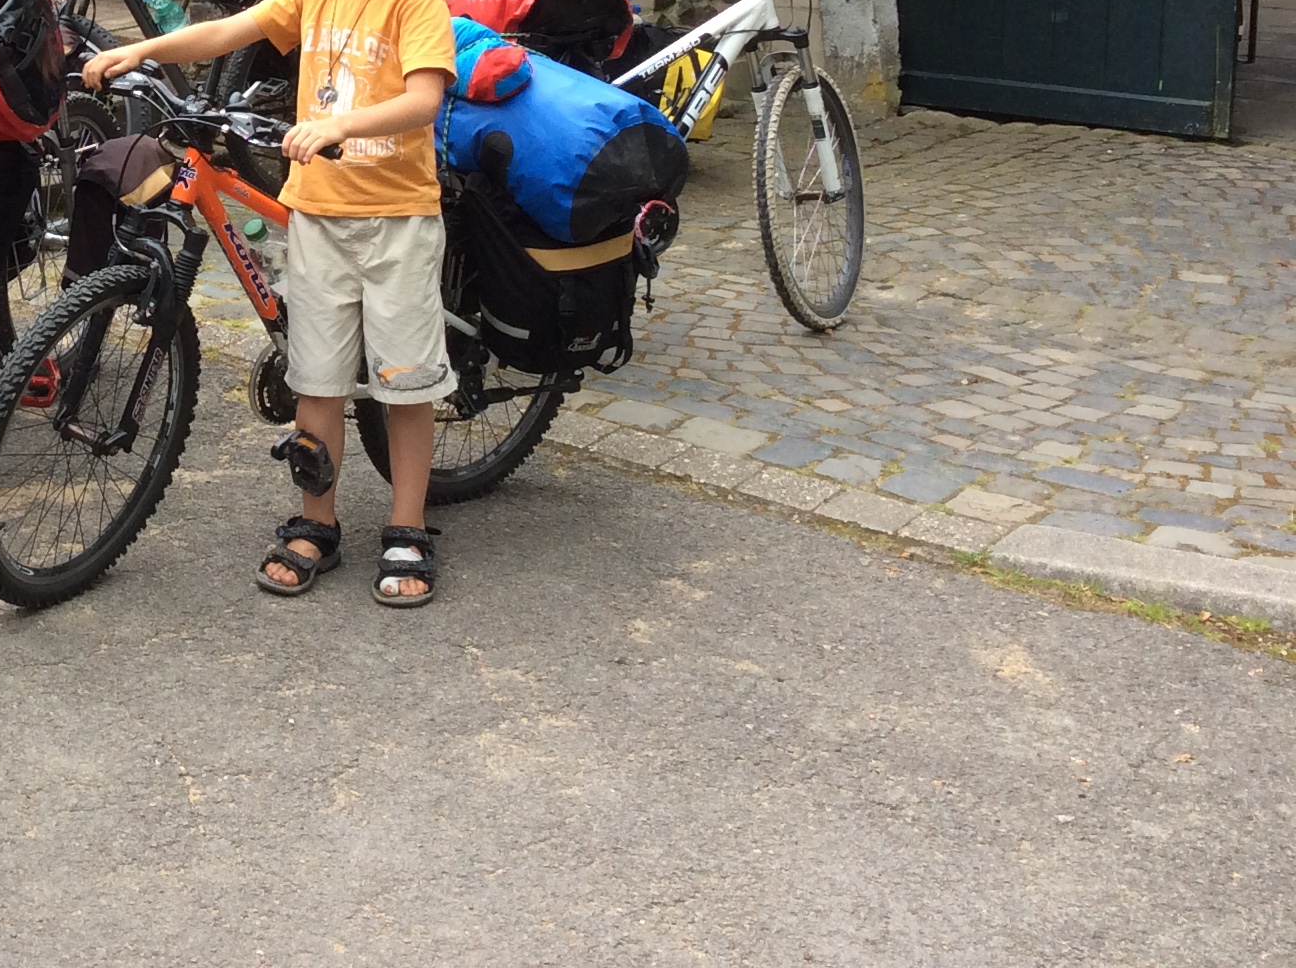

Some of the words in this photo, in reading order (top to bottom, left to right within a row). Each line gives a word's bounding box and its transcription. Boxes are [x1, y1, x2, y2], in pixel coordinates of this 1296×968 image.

[303, 27, 361, 57] LABEL
[364, 36, 389, 67] OF
[681, 63, 727, 142] UBE
[345, 136, 396, 157] GOODS
